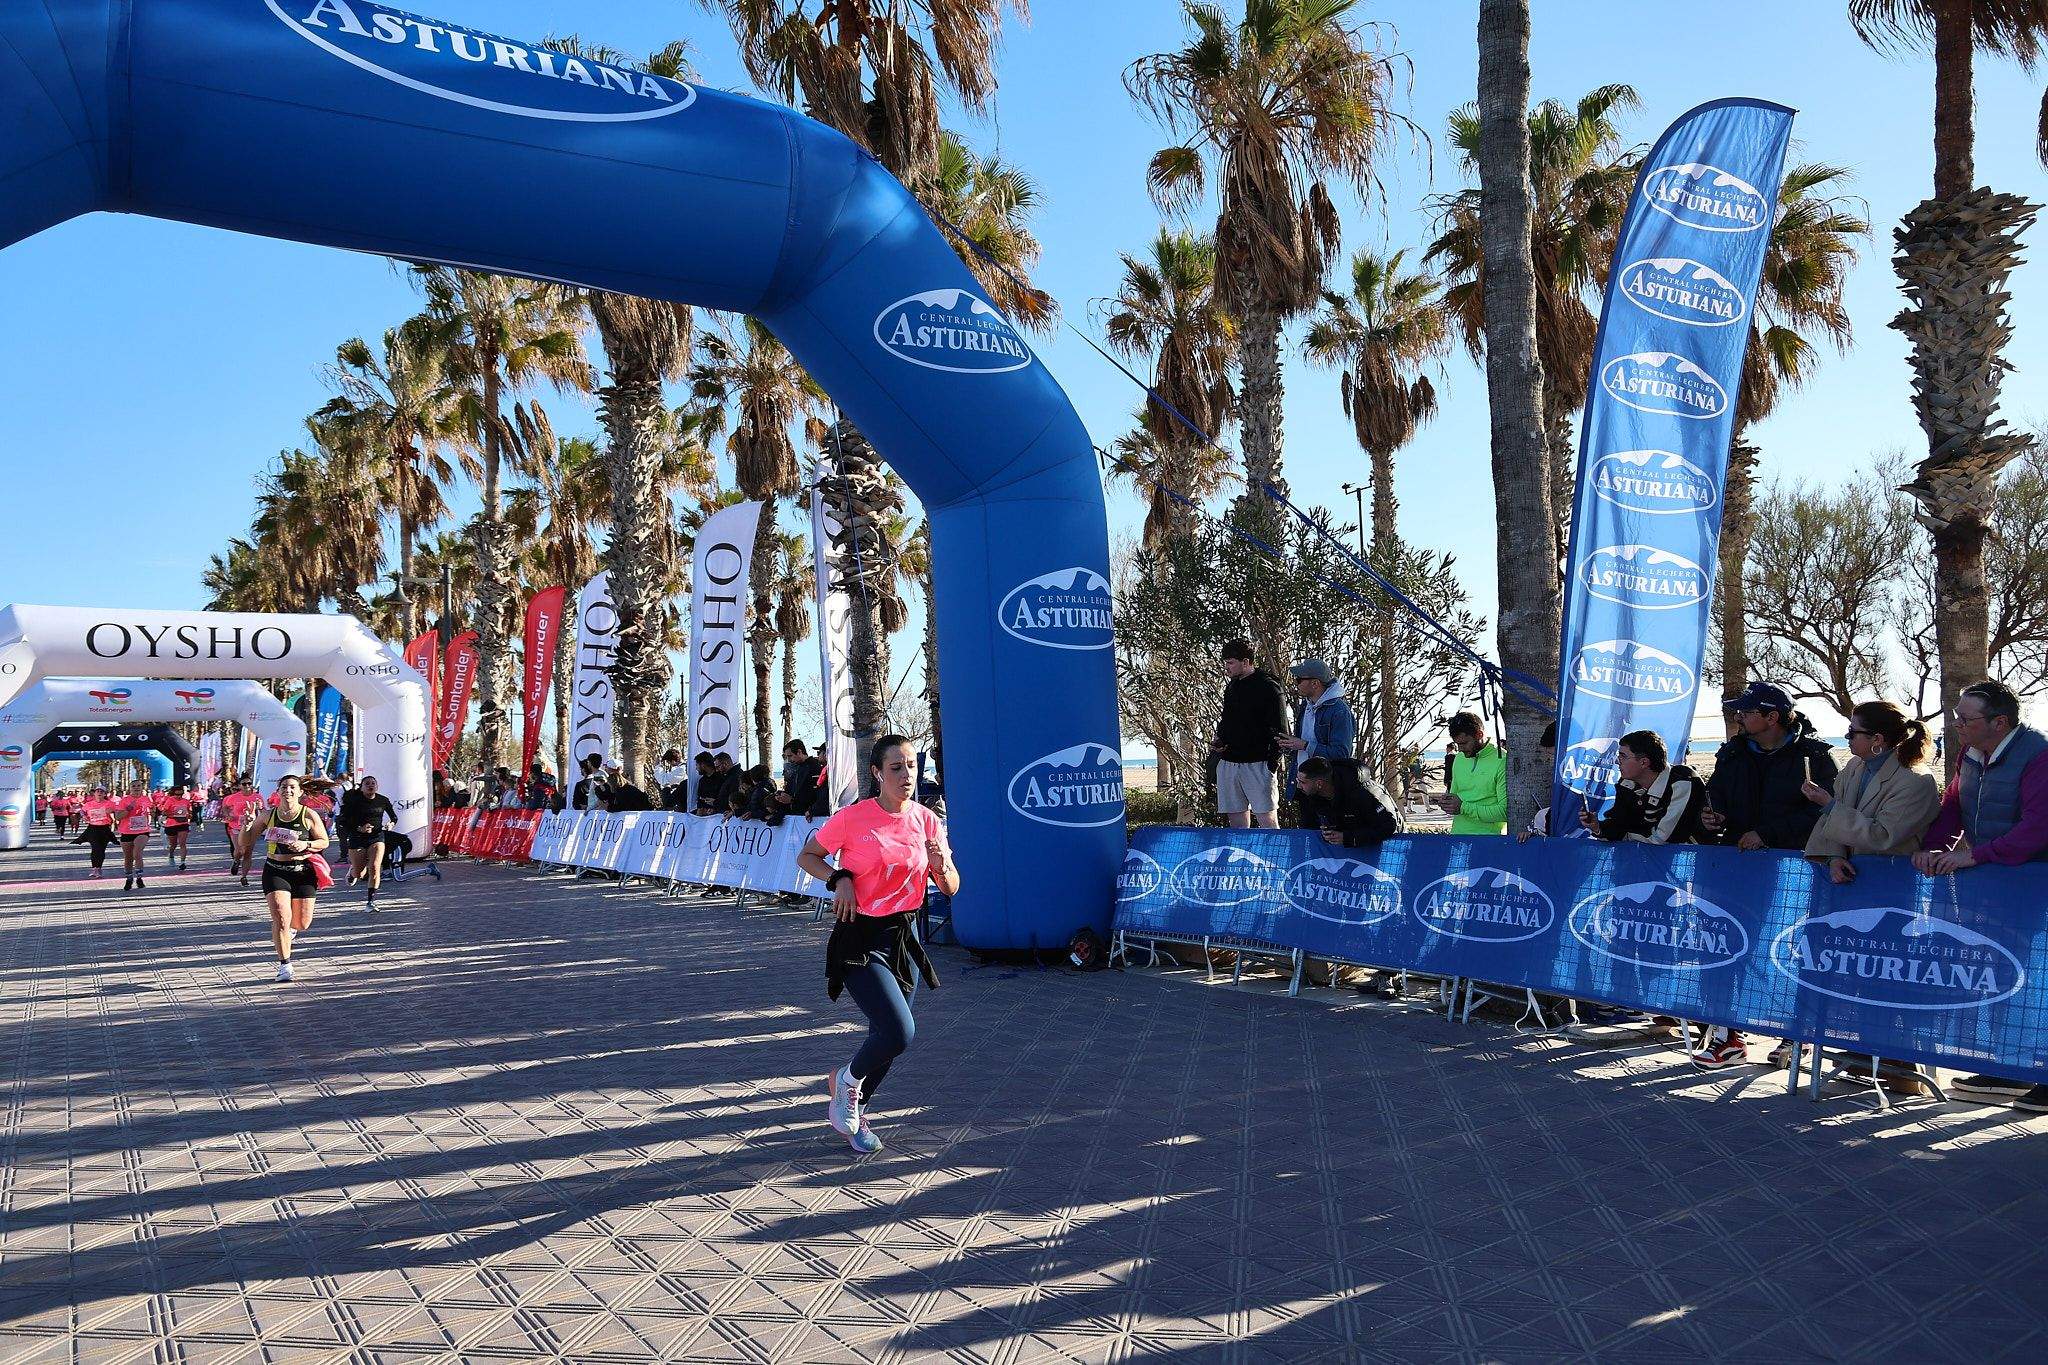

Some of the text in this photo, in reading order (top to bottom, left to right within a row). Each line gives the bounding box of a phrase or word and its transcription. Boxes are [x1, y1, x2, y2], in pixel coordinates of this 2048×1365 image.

[301, 0, 674, 103] ASTURIANA
[1651, 177, 1758, 224] ASTURIANA
[1673, 178, 1711, 195] CENTRAL
[1627, 270, 1733, 318] ASTURIANA
[1650, 272, 1690, 288] CENTRAL
[920, 313, 973, 326] CENTRAL
[888, 312, 1028, 360] ASTURIANA
[1609, 366, 1717, 412] ASTURIANA
[1631, 368, 1675, 381] CENTRAL
[1597, 465, 1709, 504] ASTURIANA
[1615, 466, 1660, 479] CENTRAL
[1588, 561, 1699, 598] ASTURIANA
[1605, 560, 1646, 574] CENTRAL
[1038, 595, 1087, 605] CENTRAL
[86, 622, 292, 661] OYSHO
[531, 611, 549, 701] Santander
[696, 542, 743, 750] OYSHO
[346, 665, 400, 676] OYSHO
[446, 650, 471, 720] Santander
[1577, 656, 1684, 694] ASTURIANA
[57, 734, 149, 743] VOLVO
[1048, 771, 1098, 782] CENTRAL
[538, 816, 573, 840] OYSHO
[583, 818, 624, 844] OYSHO
[639, 820, 686, 849] OYSHO
[708, 825, 773, 857] OYSHO
[1177, 867, 1264, 891] ASTURIANA
[1289, 872, 1392, 913] ASTURIANA
[1421, 890, 1541, 928] ASTURIANA
[1610, 905, 1665, 920] CENTRAL
[1580, 904, 1732, 956] ASTURIANA
[1786, 934, 2001, 994] ASTURIANA
[1823, 935, 1995, 962] CENTRAL LECHERA
